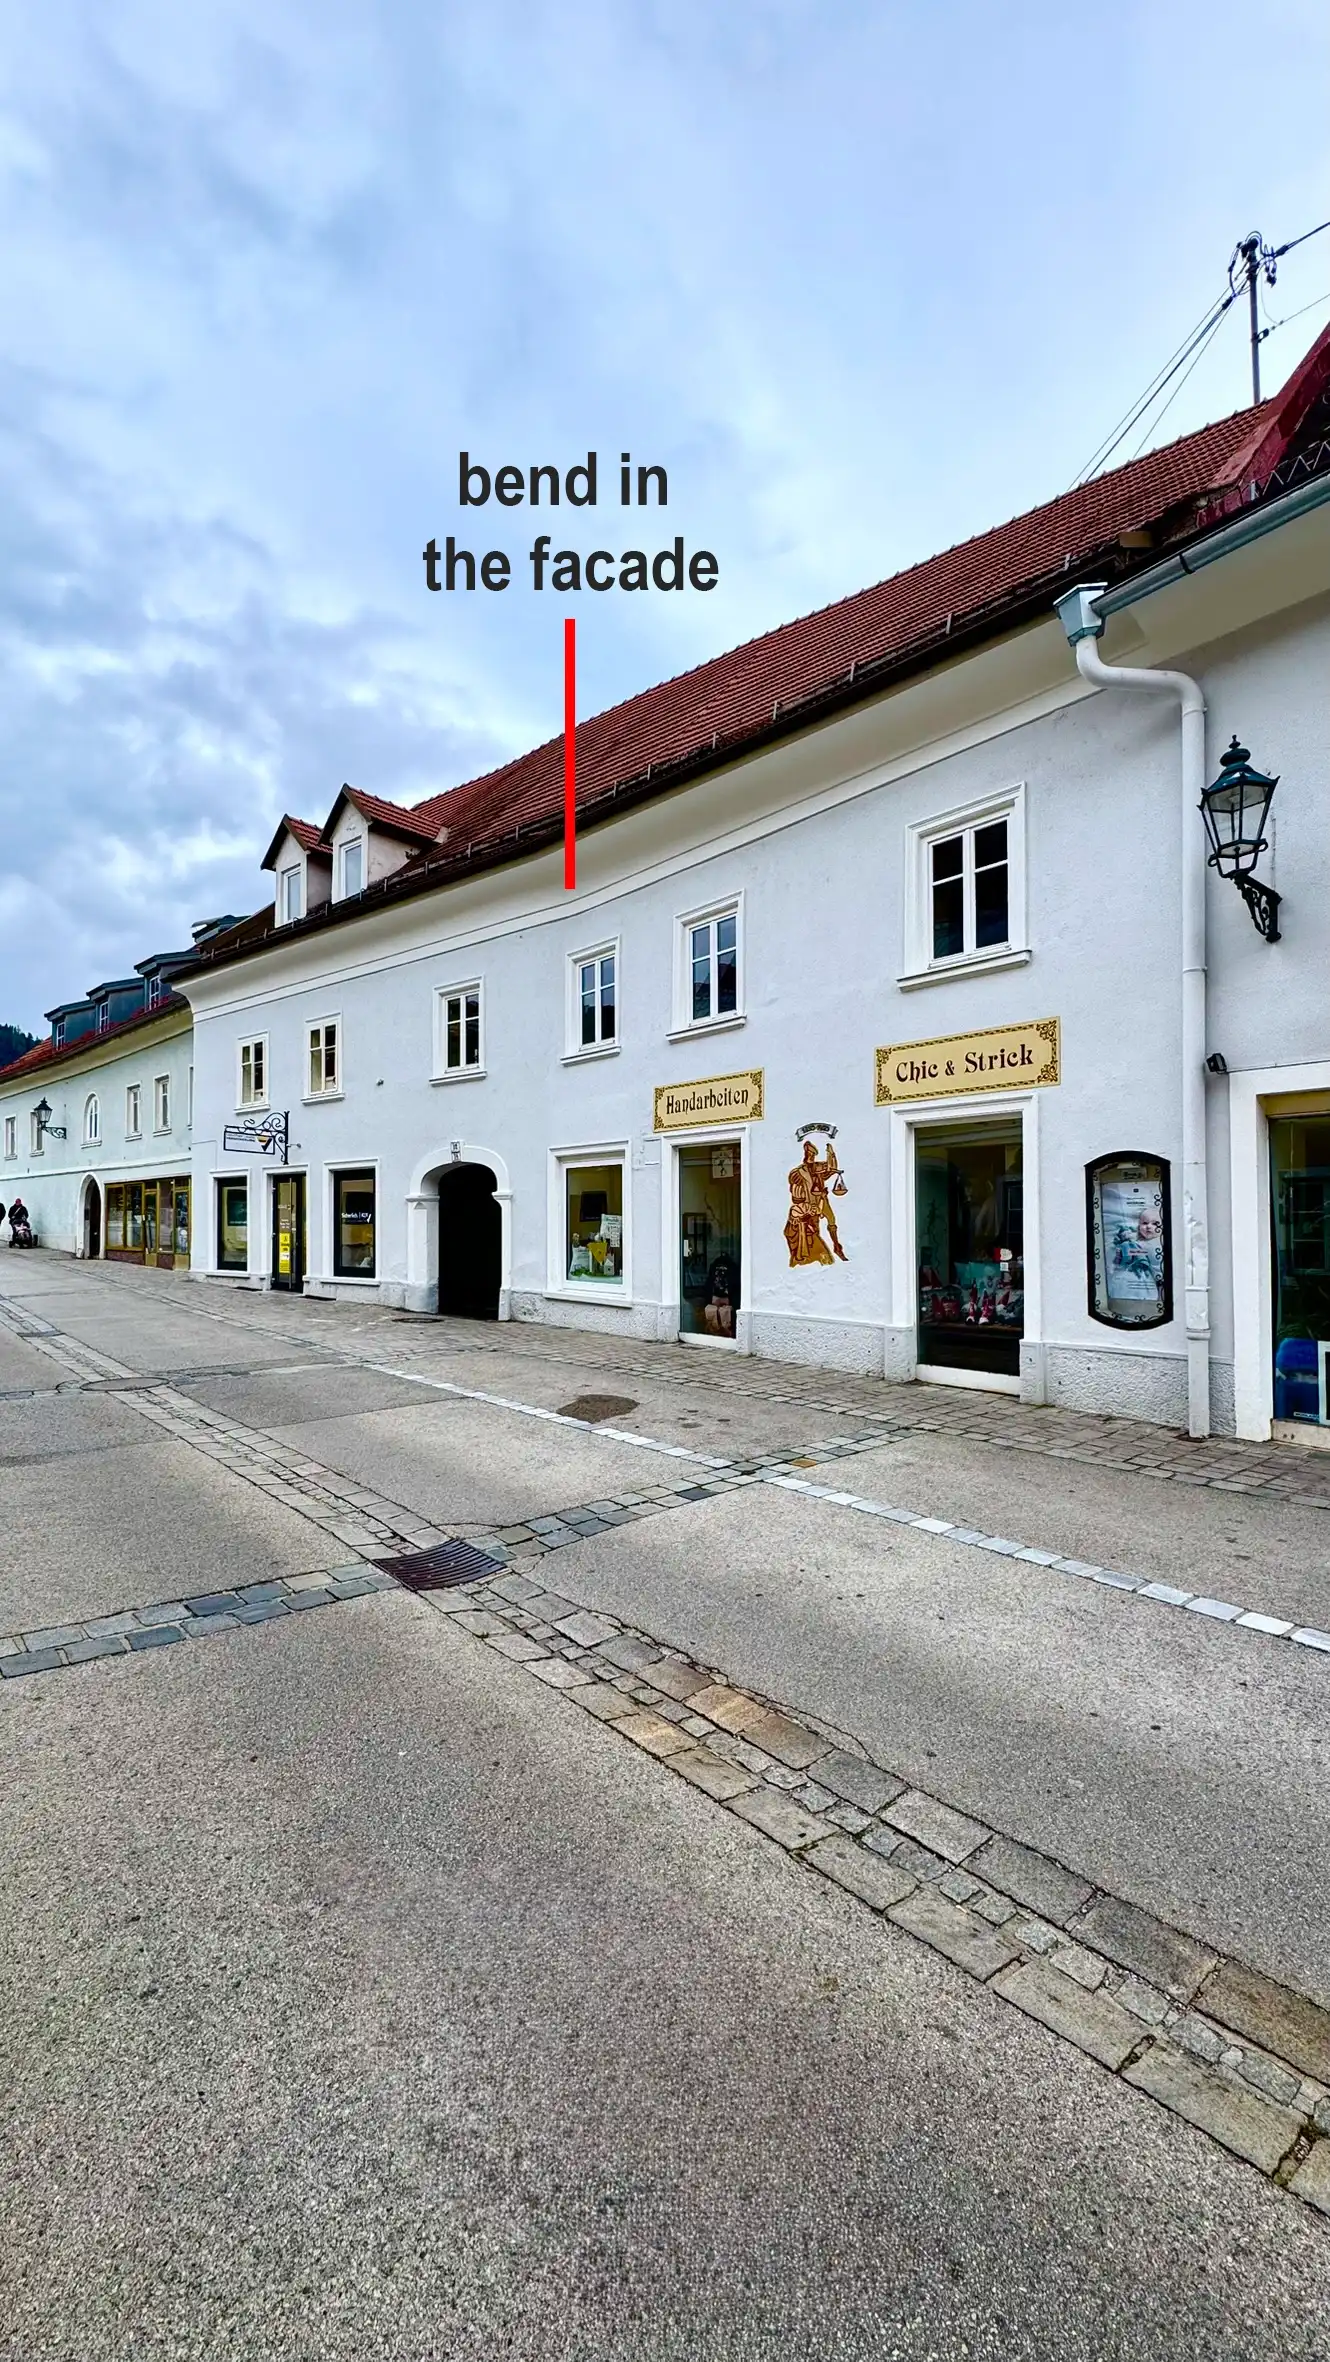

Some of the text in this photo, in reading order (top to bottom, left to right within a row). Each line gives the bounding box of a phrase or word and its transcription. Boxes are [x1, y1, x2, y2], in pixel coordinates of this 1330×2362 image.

[895, 1043, 1034, 1084] Chic & Strick
[665, 1087, 749, 1115] Handarbeiten
